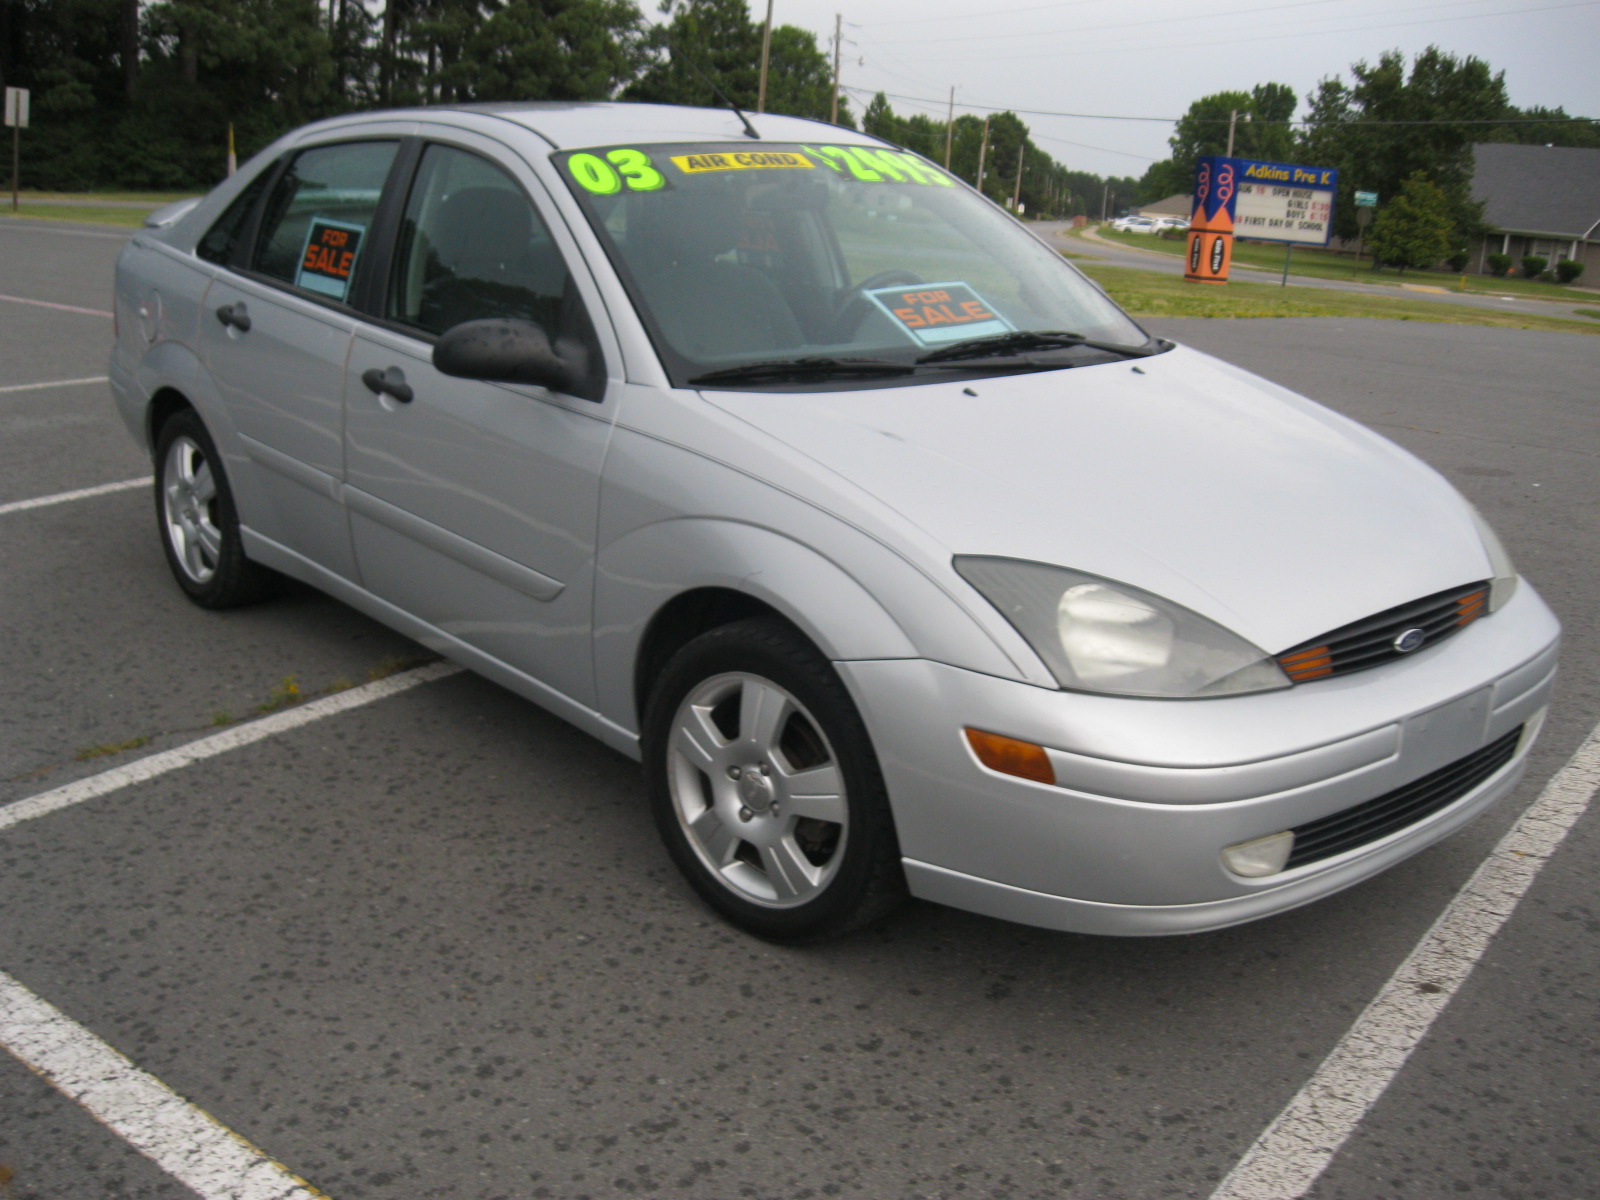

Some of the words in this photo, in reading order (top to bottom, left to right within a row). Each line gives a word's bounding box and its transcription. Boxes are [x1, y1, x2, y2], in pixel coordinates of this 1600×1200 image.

[686, 153, 727, 169] AIR
[567, 148, 666, 194] 03
[1246, 165, 1288, 180] Adkins
[1294, 169, 1316, 184] Pre
[1320, 172, 1331, 185] K
[1272, 186, 1290, 196] OPEN
[1292, 188, 1313, 199] HOUSE
[1287, 199, 1309, 209] GIRLS
[1286, 210, 1306, 219] BOYS
[1244, 216, 1266, 225] FIRST
[1269, 218, 1283, 227] DAY
[1285, 219, 1294, 228] OF
[1298, 221, 1324, 231] SCHOOL
[322, 229, 348, 246] FOR
[304, 245, 354, 276] SALE
[902, 290, 951, 304] FOR
[892, 301, 993, 327] SALE
